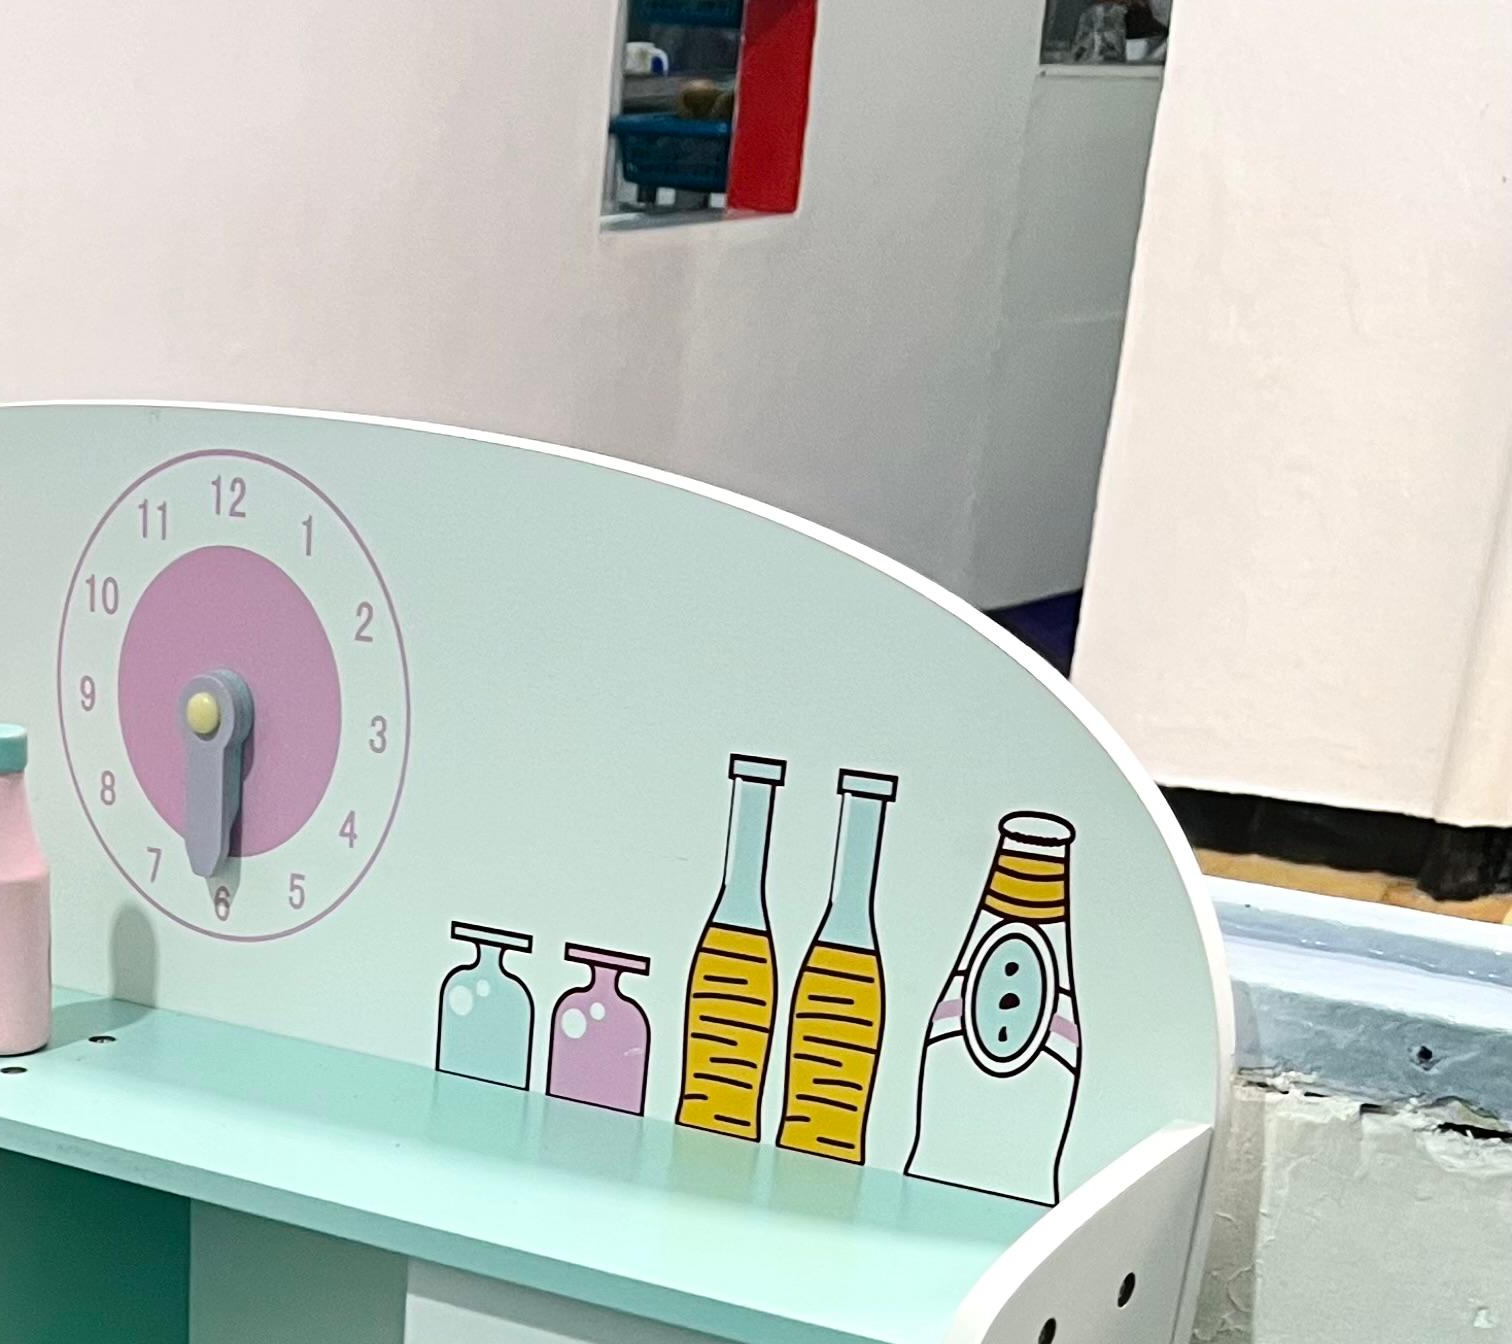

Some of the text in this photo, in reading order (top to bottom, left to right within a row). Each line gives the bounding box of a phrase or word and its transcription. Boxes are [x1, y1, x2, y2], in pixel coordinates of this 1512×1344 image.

[210, 475, 247, 519] 12
[138, 498, 168, 541] 11
[302, 515, 314, 557] 1
[84, 573, 120, 616] 10
[354, 600, 375, 643] 2
[79, 675, 97, 712] 9
[369, 715, 388, 754] 3
[99, 770, 117, 806] 8
[339, 810, 359, 849] 4
[146, 846, 163, 883] 7
[214, 885, 232, 922] 6
[288, 872, 307, 910] 5
